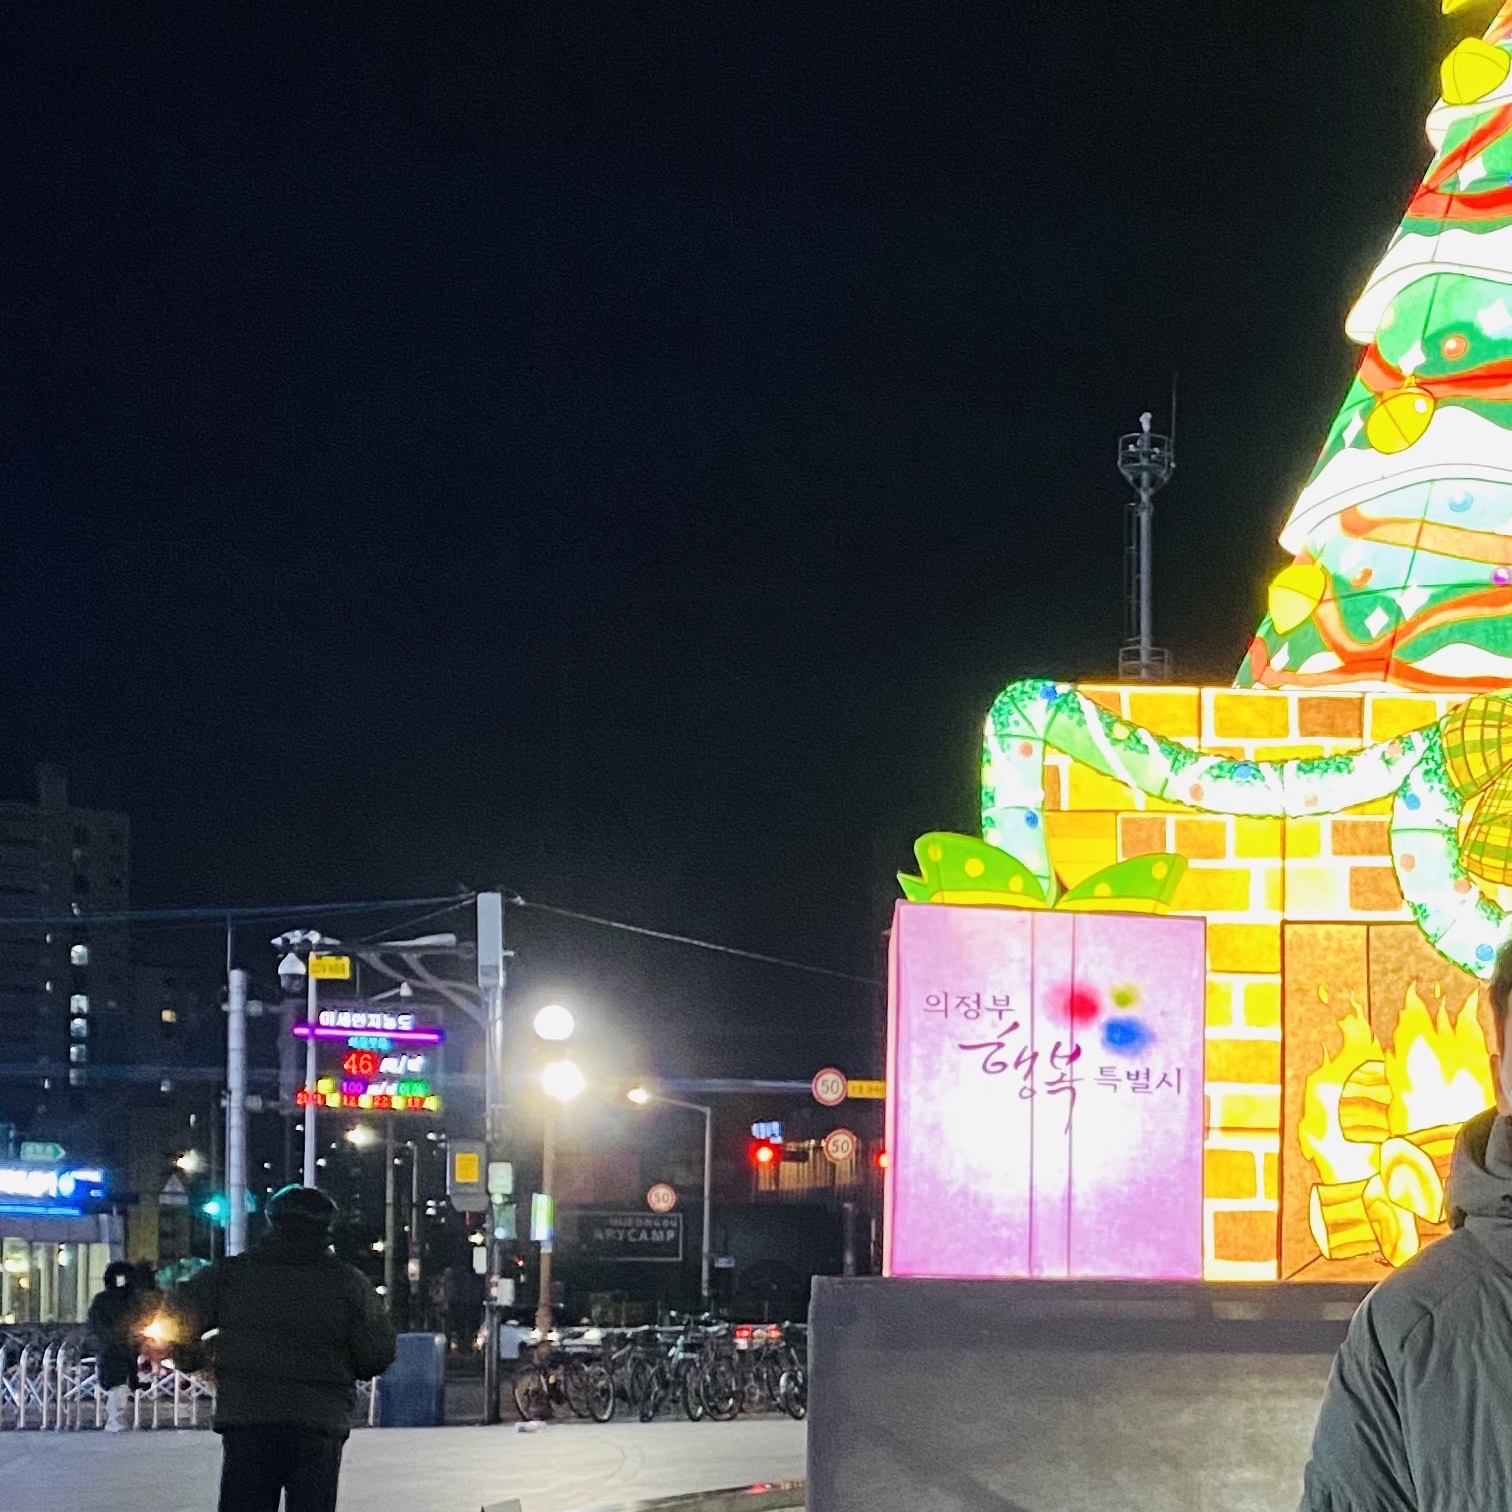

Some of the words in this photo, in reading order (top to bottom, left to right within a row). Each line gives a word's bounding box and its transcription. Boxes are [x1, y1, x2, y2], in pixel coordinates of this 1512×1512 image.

[922, 990, 1016, 1021] 의정부
[343, 1053, 374, 1075] 46
[820, 1078, 840, 1095] 50
[957, 1020, 1084, 1135] 행복
[1094, 1065, 1183, 1095] 특별시
[831, 1139, 850, 1154] 50
[654, 1192, 670, 1204] 50
